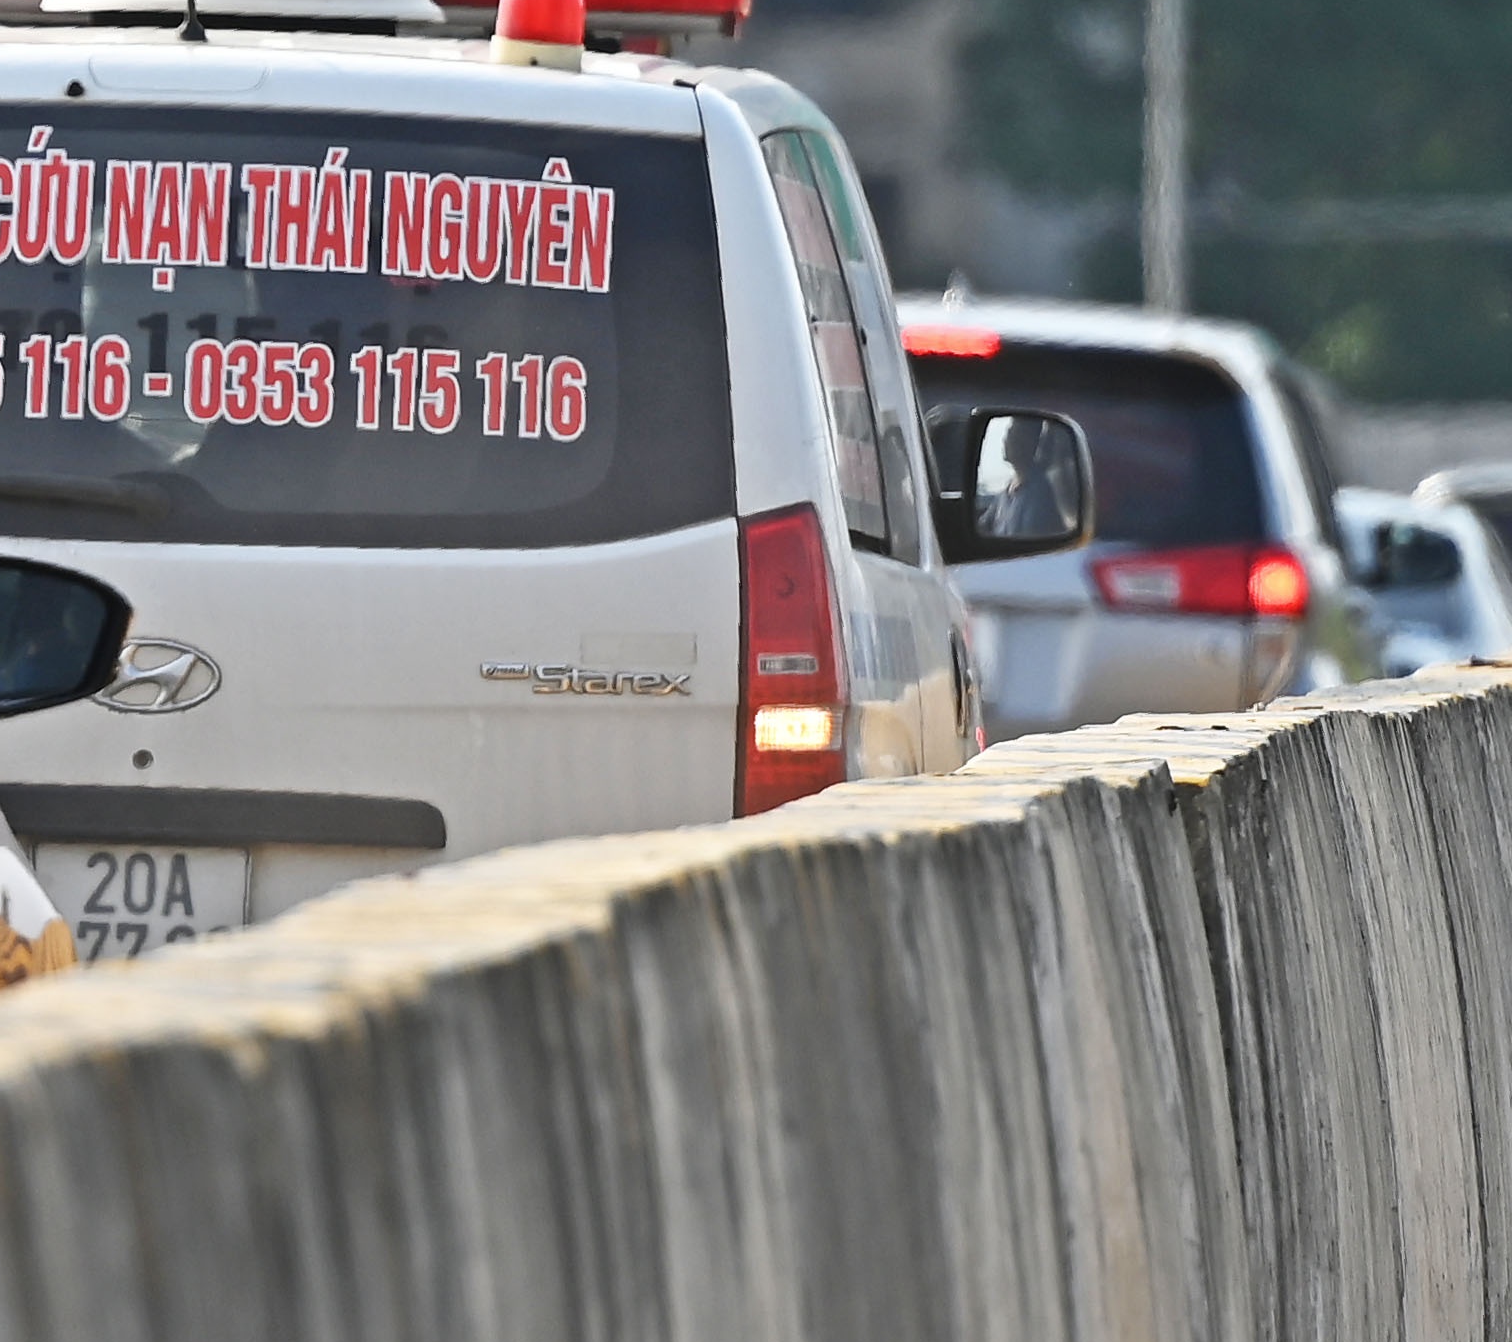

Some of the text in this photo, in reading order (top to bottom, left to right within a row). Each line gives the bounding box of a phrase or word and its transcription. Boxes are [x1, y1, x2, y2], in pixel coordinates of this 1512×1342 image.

[103, 158, 232, 292] NẠN
[242, 146, 372, 273] THÁI
[381, 157, 615, 293] NGUYÊN
[20, 333, 131, 421] 116
[142, 373, 172, 396] -
[184, 338, 334, 426] 0353
[351, 345, 461, 434] 115
[476, 352, 587, 443] 116
[532, 662, 692, 696] Starex
[83, 851, 194, 917] 20A
